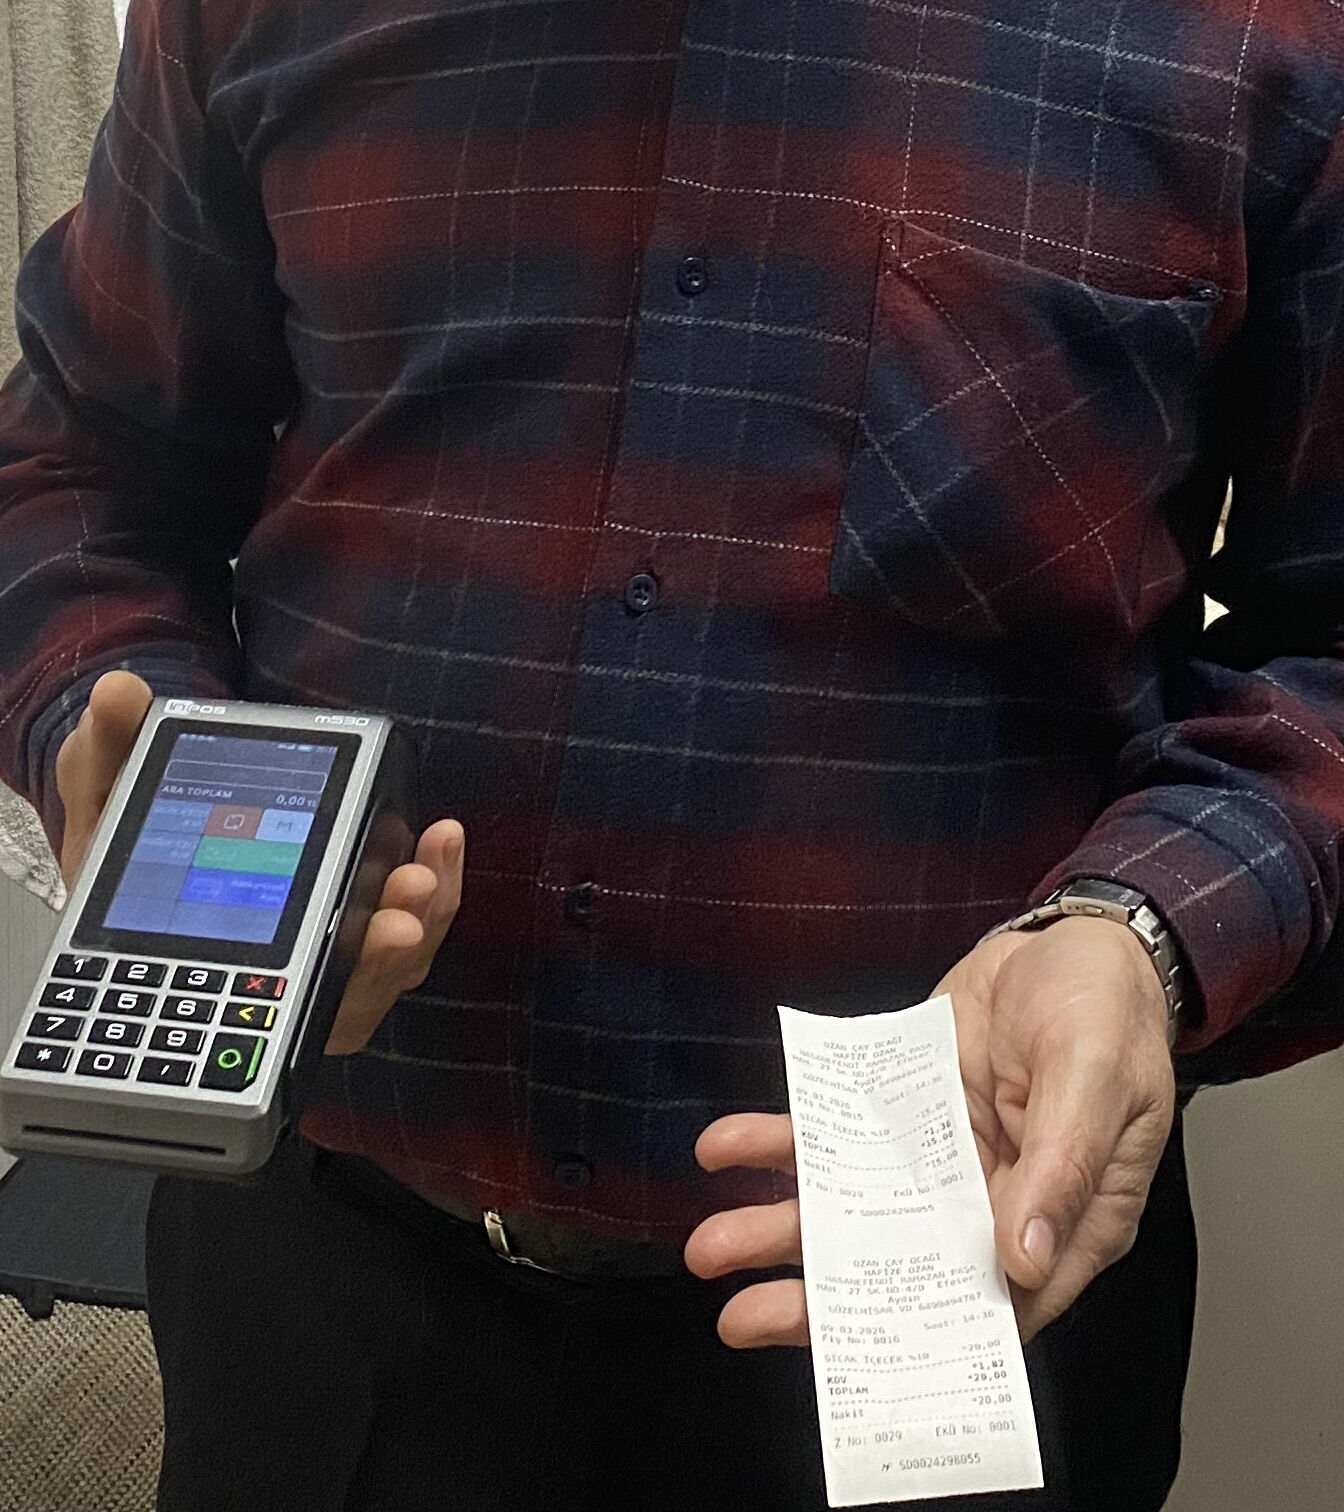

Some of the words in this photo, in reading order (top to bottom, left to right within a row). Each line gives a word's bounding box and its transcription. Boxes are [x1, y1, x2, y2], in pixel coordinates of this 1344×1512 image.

[314, 715, 370, 727] m530
[161, 786, 185, 796] ARA
[187, 787, 233, 799] TOPLAM
[74, 958, 84, 973] 1
[128, 964, 149, 980] 2
[187, 969, 208, 986] 3
[55, 987, 75, 1003] 4
[176, 1000, 197, 1016] 6
[46, 1016, 66, 1032] 7
[105, 1023, 126, 1040] 8
[166, 1030, 187, 1047] 9
[93, 1053, 114, 1071] 0
[853, 1259, 879, 1268] OZAN
[885, 1258, 904, 1268] ÇAY
[910, 1252, 942, 1265] OCAĞI
[908, 1264, 934, 1274] OZAN
[887, 1295, 920, 1306] Aydın
[827, 1375, 847, 1385] KDV
[828, 1386, 869, 1396] TOPLAM
[831, 1408, 864, 1420] Nakit
